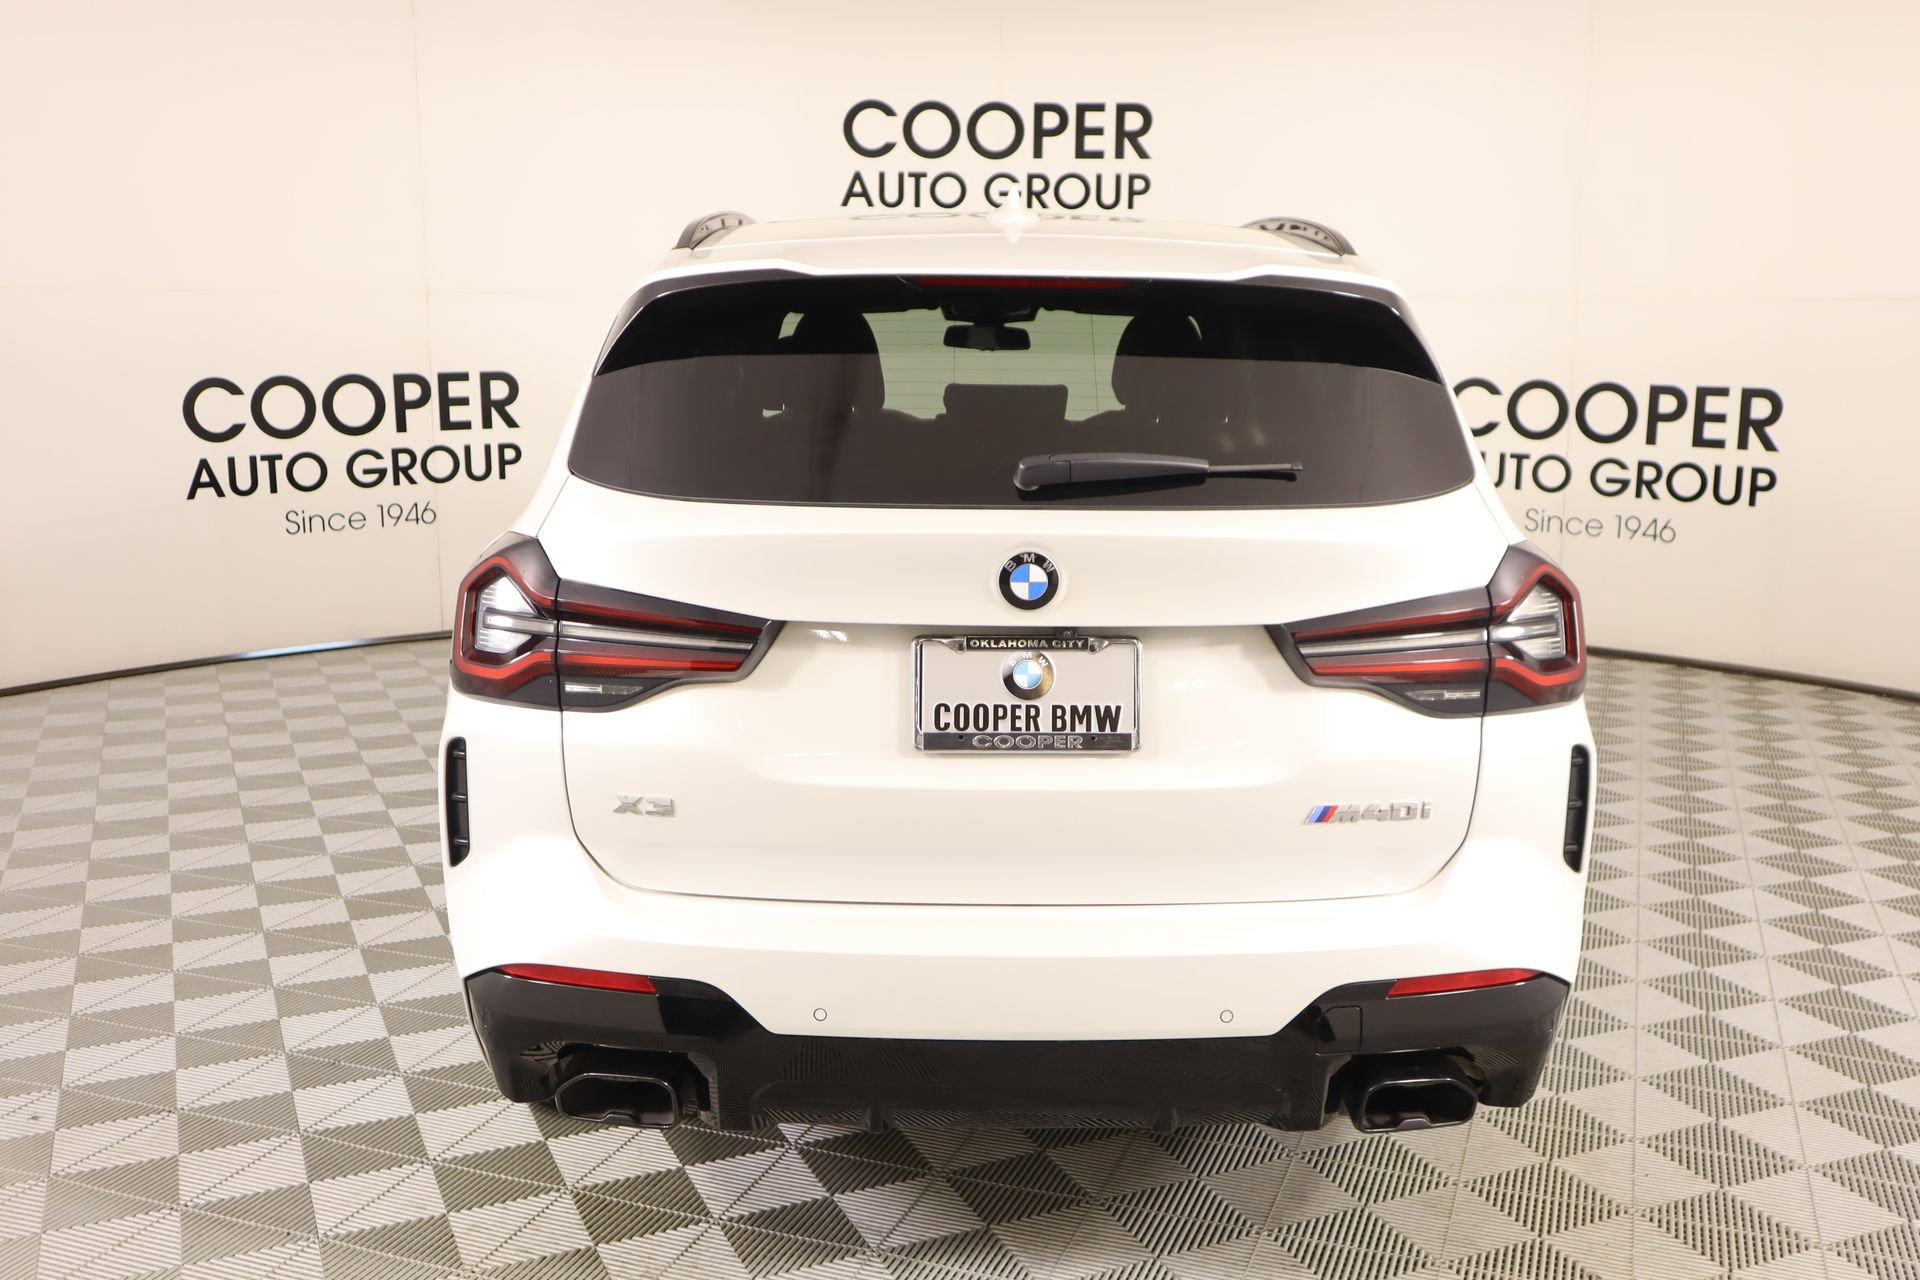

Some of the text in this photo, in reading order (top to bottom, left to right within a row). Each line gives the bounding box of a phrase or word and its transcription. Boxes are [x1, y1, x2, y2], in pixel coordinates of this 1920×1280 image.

[843, 99, 1153, 160] COOPER
[841, 170, 1151, 210] AUTO GROUP
[182, 371, 520, 443] COOPER
[1453, 377, 1784, 453] COOPER
[186, 442, 522, 500] AUTO GROUP
[1481, 451, 1777, 507] UTO GROUP
[285, 500, 437, 535] Since 1946
[1524, 507, 1677, 543] Since 1946
[1004, 553, 1056, 573] BMW
[969, 639, 1085, 649] OKLAHOMA CITY
[1008, 651, 1049, 668] BMW
[934, 703, 1122, 733] COOPER BMW
[972, 735, 1084, 749] COOPER
[612, 793, 674, 817] X3
[1326, 800, 1432, 824] M40i
